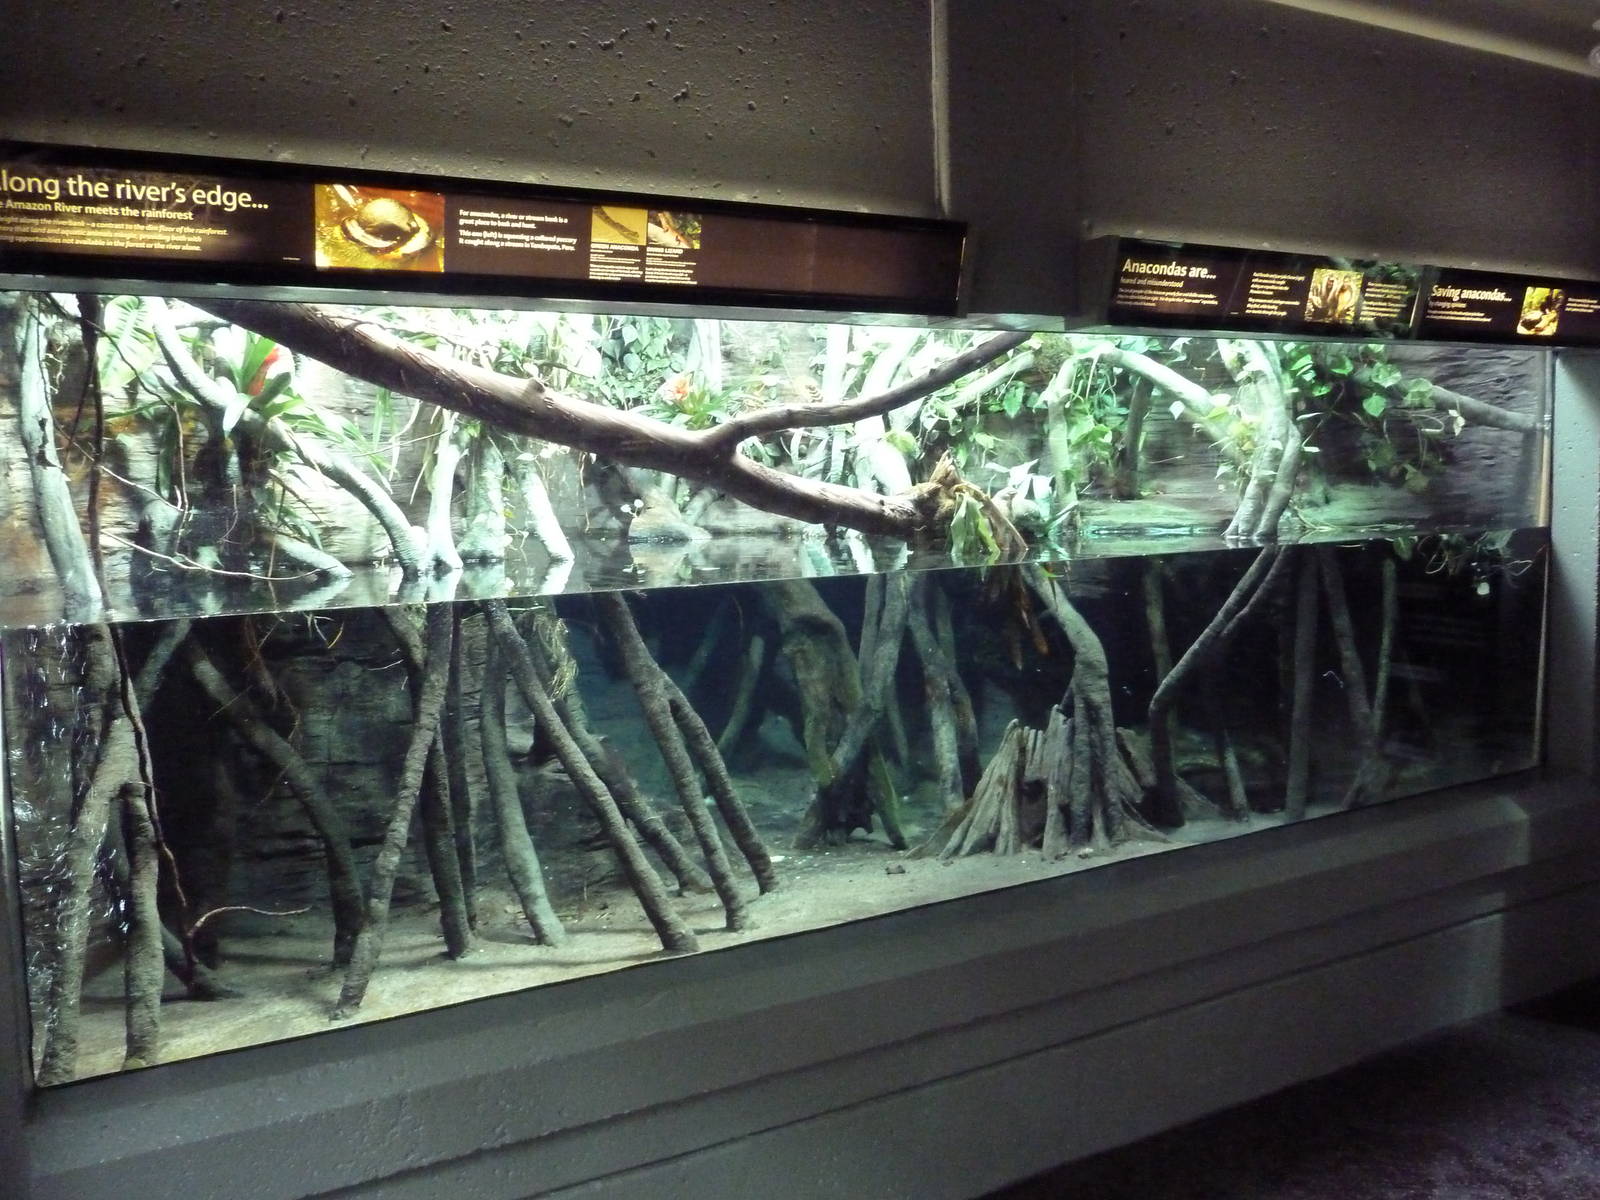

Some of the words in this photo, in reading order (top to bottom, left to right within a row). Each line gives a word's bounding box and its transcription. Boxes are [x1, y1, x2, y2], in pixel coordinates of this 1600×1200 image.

[0, 169, 60, 199] long
[66, 174, 109, 198] the
[115, 179, 187, 203] river's
[192, 185, 269, 212] edge...
[5, 199, 52, 211] Amazon
[54, 202, 83, 213] River
[85, 205, 119, 216] meets
[121, 207, 140, 217] the
[141, 208, 194, 220] rainforest
[1122, 258, 1188, 277] Anacondas
[1431, 285, 1462, 301] Saving
